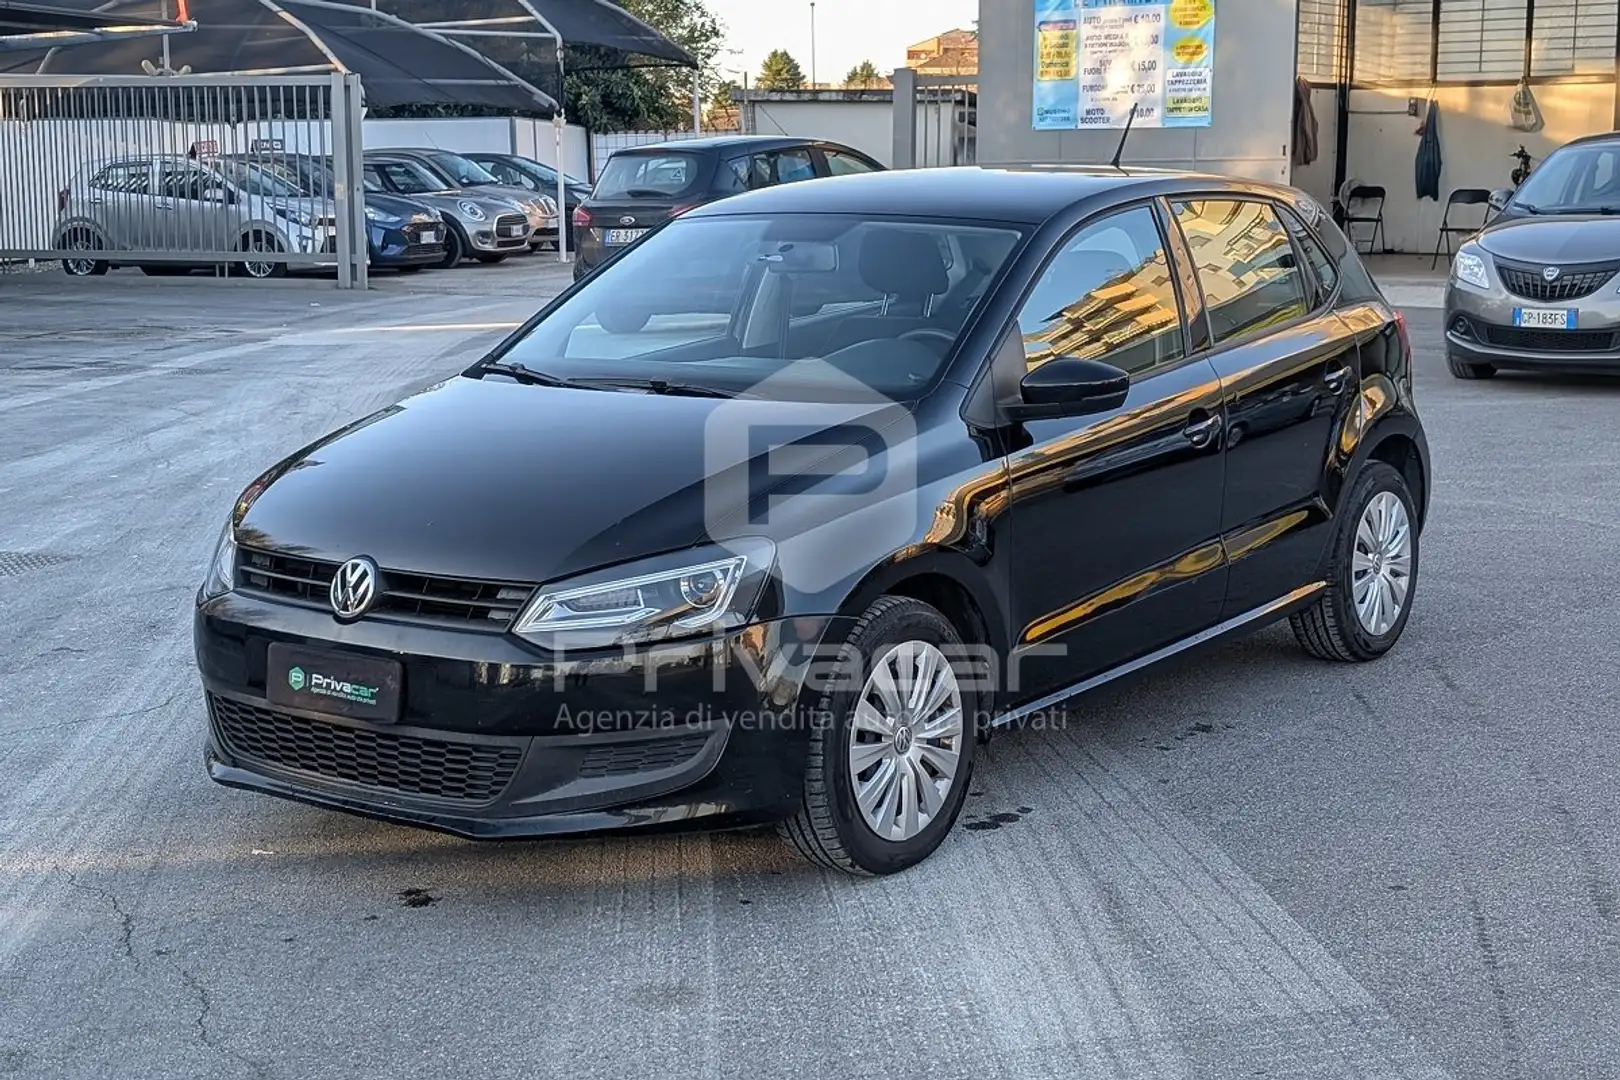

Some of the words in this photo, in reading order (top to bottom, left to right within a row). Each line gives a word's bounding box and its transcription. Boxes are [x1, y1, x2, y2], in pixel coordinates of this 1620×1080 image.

[1083, 16, 1101, 24] AUTO
[1138, 60, 1157, 72] 15,00
[1085, 108, 1105, 116] MOTO
[1080, 116, 1111, 124] SCOOTER
[311, 674, 379, 698] Privacar
